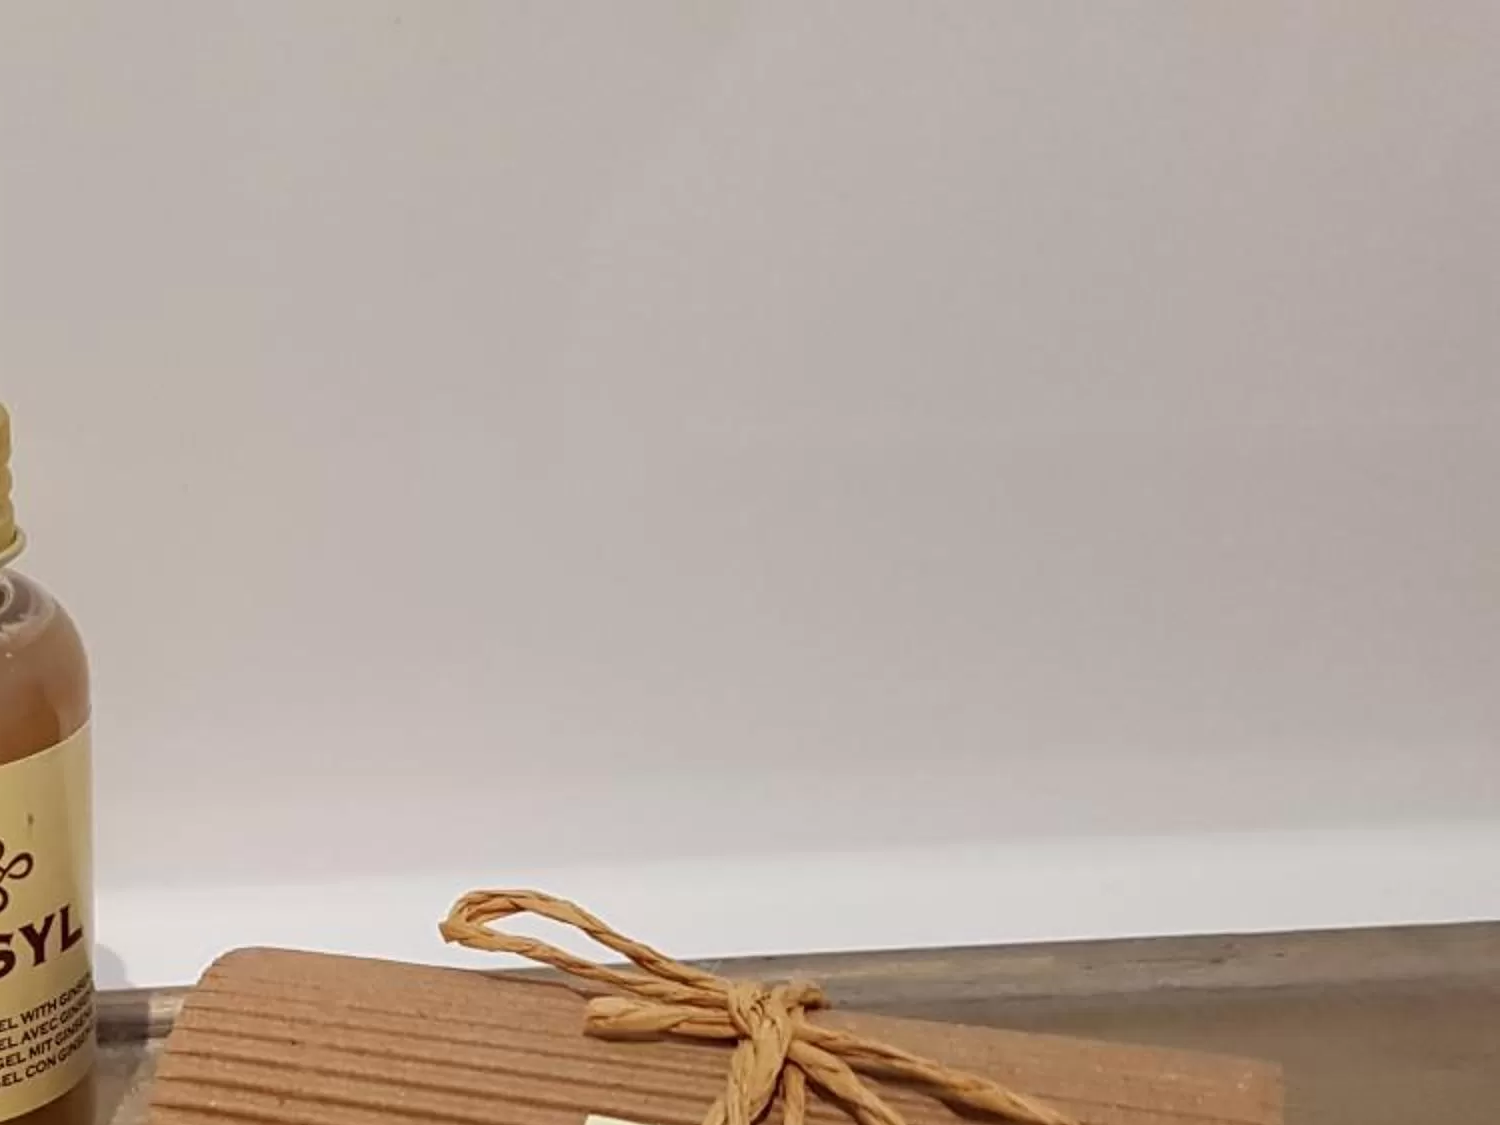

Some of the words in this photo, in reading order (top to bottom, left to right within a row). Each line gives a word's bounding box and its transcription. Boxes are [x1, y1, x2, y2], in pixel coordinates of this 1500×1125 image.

[20, 999, 57, 1026] WITH
[20, 1016, 58, 1046] AVEC
[28, 1037, 53, 1060] MIT
[25, 1055, 57, 1080] CON
